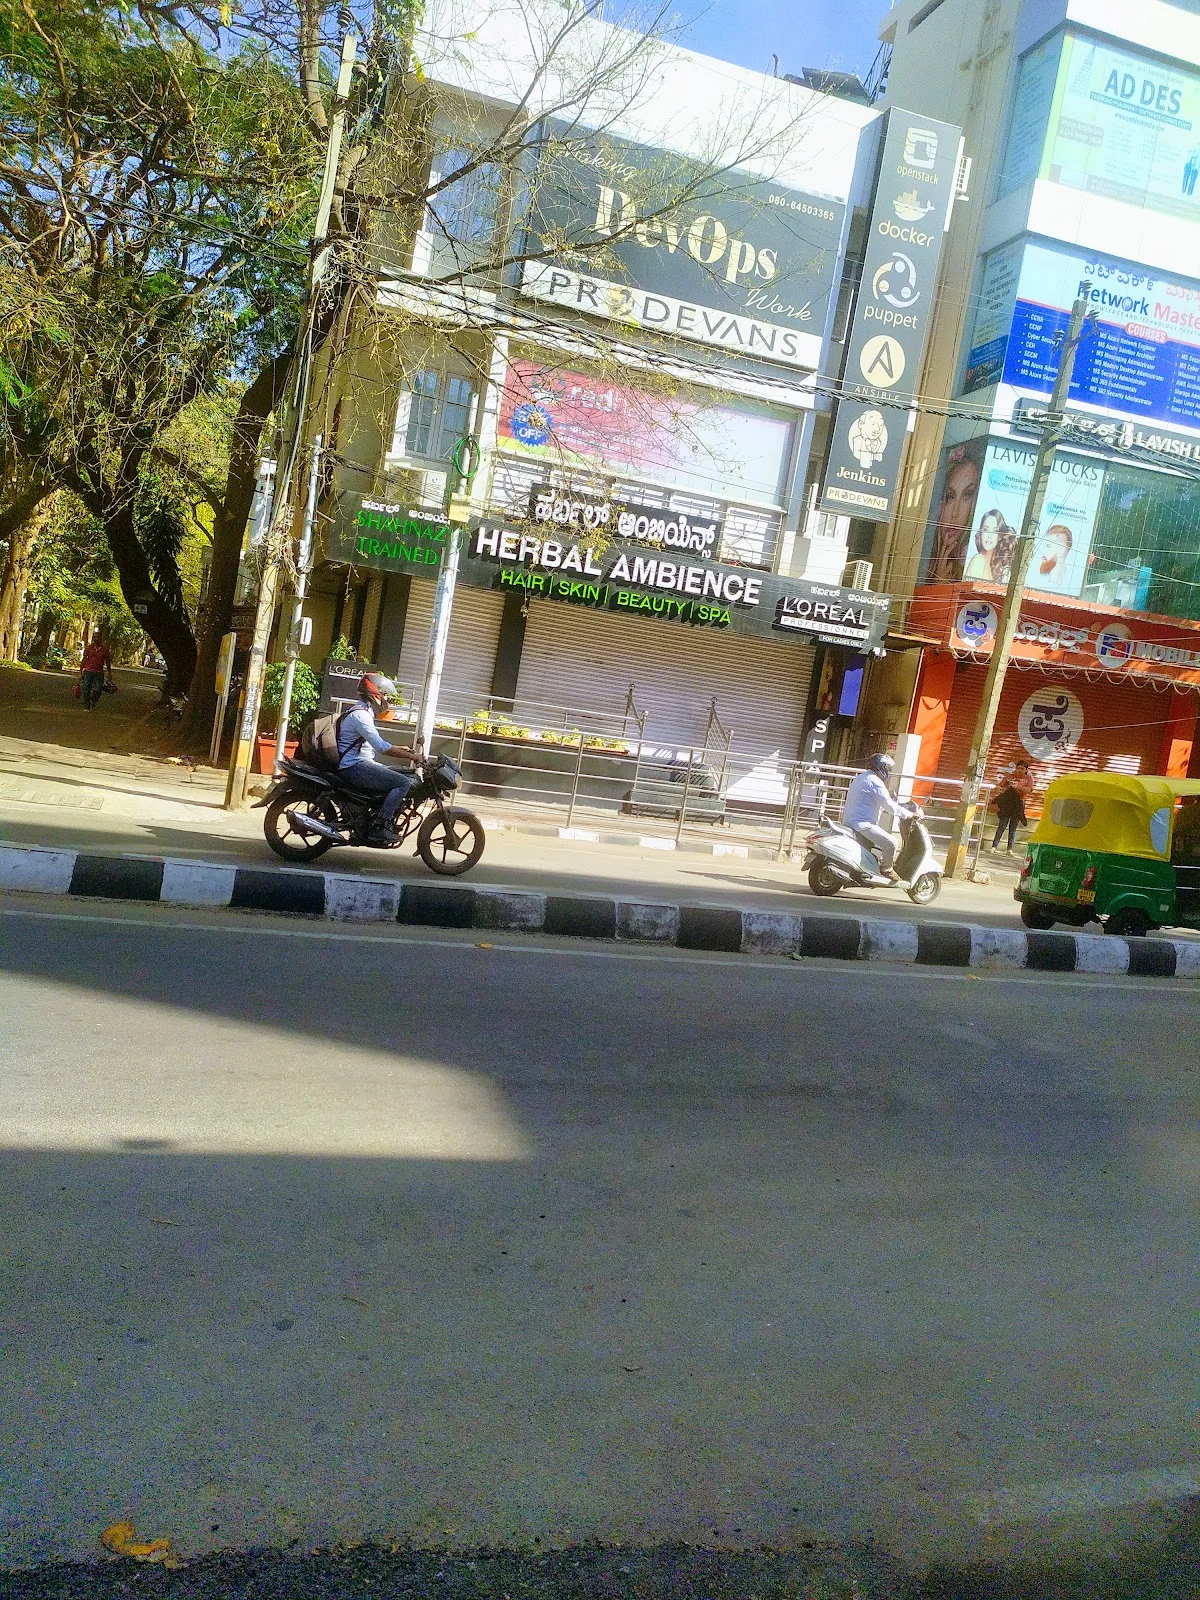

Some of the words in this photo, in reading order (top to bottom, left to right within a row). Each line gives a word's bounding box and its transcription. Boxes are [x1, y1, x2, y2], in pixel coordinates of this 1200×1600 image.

[896, 165, 939, 185] openstack
[768, 194, 835, 221] 080-64503365
[593, 183, 779, 285] DevOps
[878, 219, 935, 248] docker
[746, 288, 813, 321] Work
[864, 305, 919, 330] puppet
[1029, 323, 1042, 331] CCNP
[1027, 332, 1041, 341] Cyber
[1127, 324, 1166, 342] COURSES
[1024, 350, 1038, 358] SCCM
[1025, 341, 1036, 349] CEH
[1101, 369, 1119, 379] Security
[1119, 365, 1136, 375] Desktop
[1137, 370, 1165, 382] Administrator
[1127, 358, 1156, 370] Administrator
[854, 386, 901, 402] ANSIBLE
[1137, 431, 1192, 457] LAVISH
[993, 445, 1037, 467] LAVIS
[1051, 458, 1098, 481] LOCKS
[836, 466, 886, 487] Jenkins
[828, 488, 886, 509] PRODEVANS
[356, 510, 448, 543] SHAHNAZ
[358, 536, 440, 566] TRAINED
[476, 526, 603, 577] HERBAL
[609, 554, 763, 605] AMBIENCE
[501, 570, 545, 592] HAIR
[558, 580, 601, 601] SKIN
[617, 590, 687, 616] BEAUTY
[697, 606, 732, 624] SPA
[783, 617, 868, 638] PROFESSIONNEL
